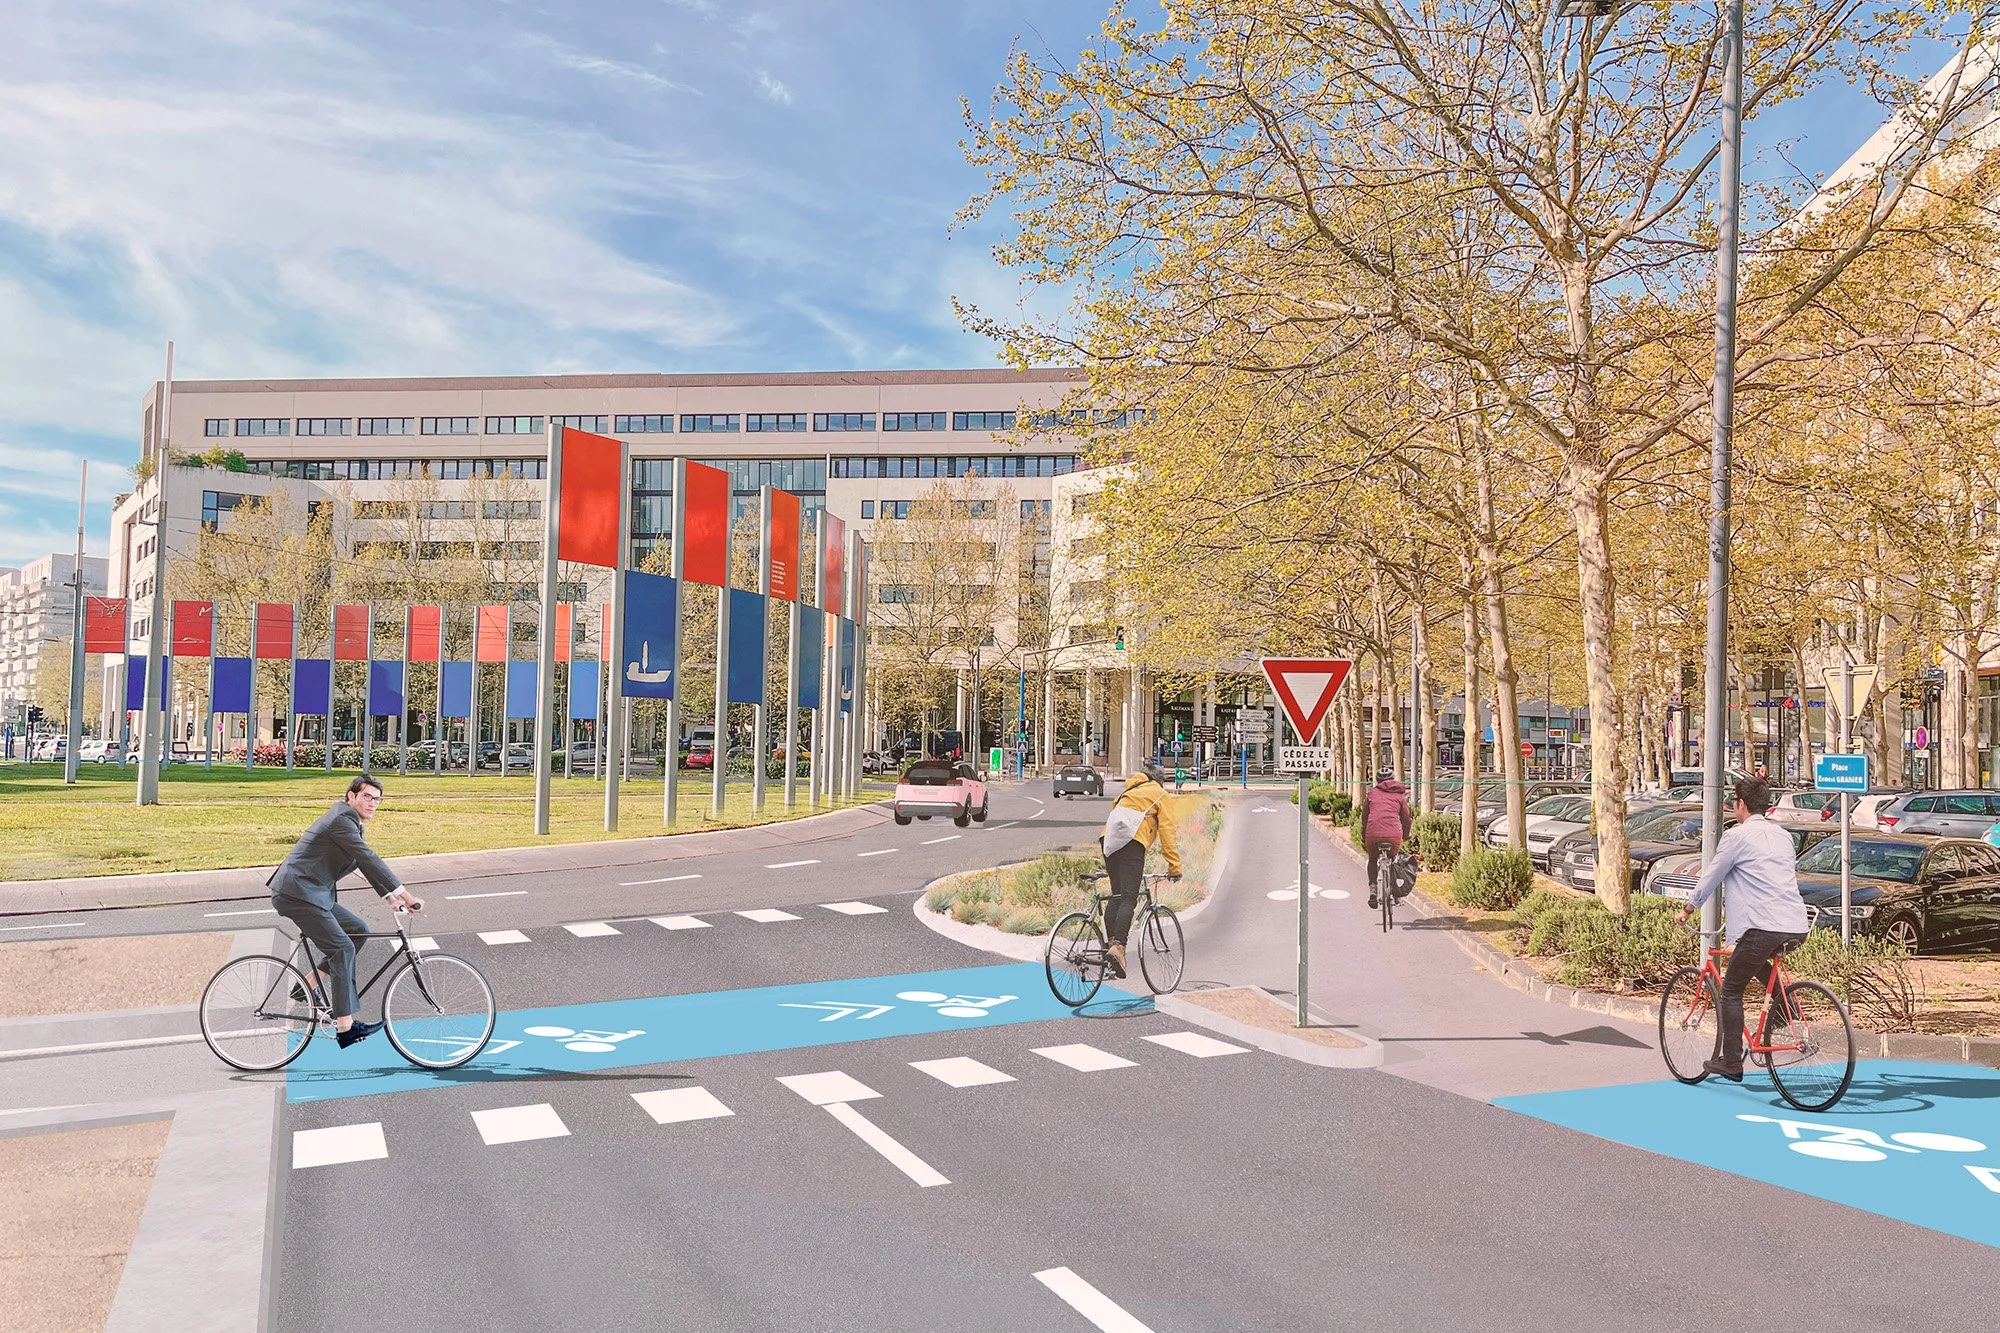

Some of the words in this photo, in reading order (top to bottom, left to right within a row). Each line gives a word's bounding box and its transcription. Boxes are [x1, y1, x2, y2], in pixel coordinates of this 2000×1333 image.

[1283, 749, 1315, 759] CÉDEZ
[1318, 750, 1329, 759] LE
[1285, 760, 1327, 768] PASSAGE
[1831, 763, 1849, 771] Place
[1836, 776, 1863, 784] GRANIER
